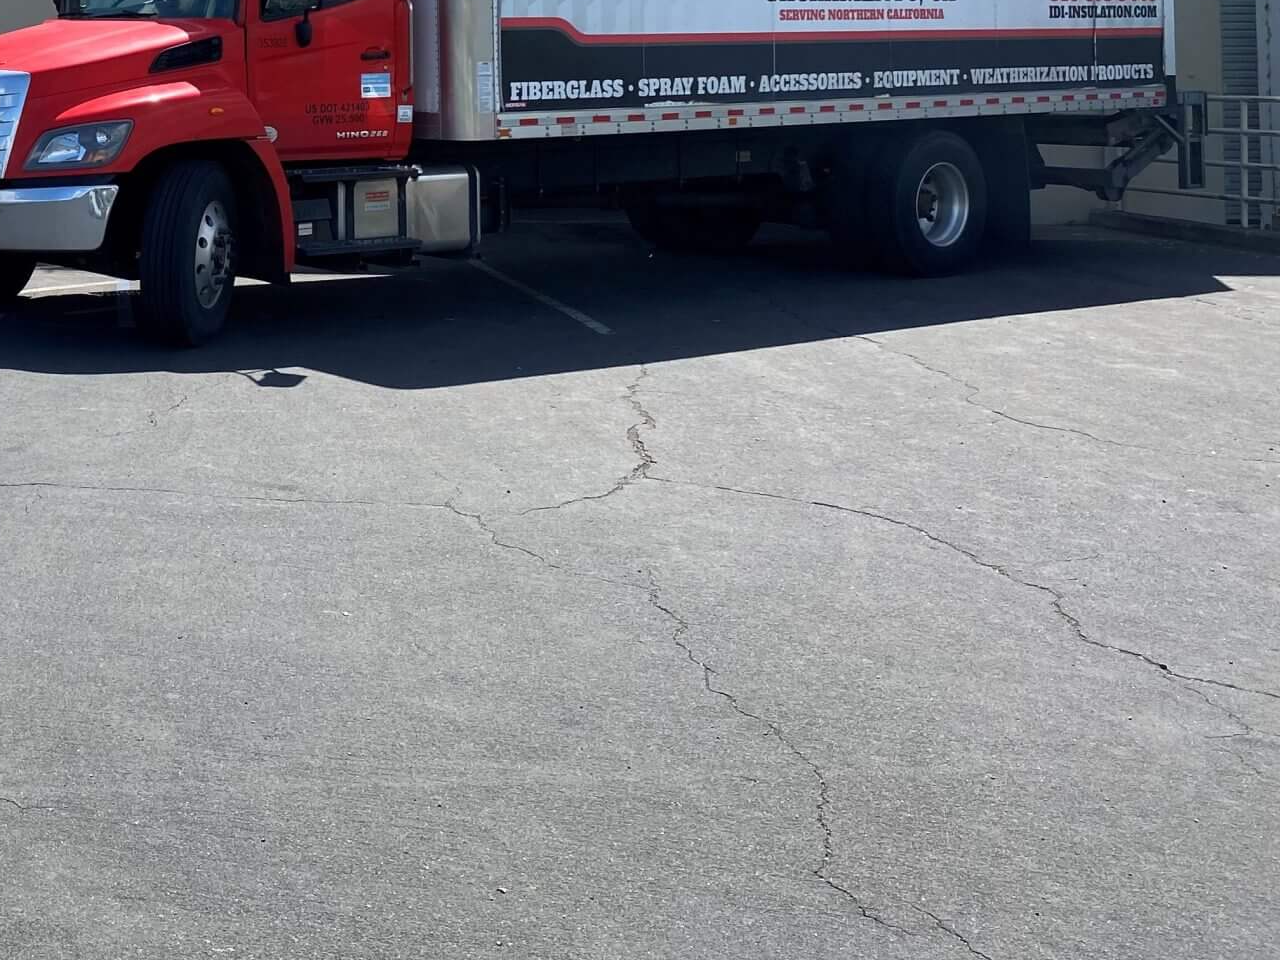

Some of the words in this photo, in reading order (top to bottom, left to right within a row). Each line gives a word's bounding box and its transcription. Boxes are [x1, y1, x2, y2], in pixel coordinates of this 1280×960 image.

[779, 9, 826, 21] SERVING
[828, 9, 885, 21] NORTHERN
[887, 8, 945, 20] CALIFORNIA
[1049, 5, 1157, 18] IDI-INSULATION.COM
[510, 79, 623, 101] FIBERGLASS
[638, 77, 694, 97] SPRAY
[697, 75, 747, 95] FOAM
[758, 71, 862, 93] ACCESSORIES
[873, 69, 960, 88] EQUIPMENT
[970, 65, 1089, 85] WEATHERIZATION
[305, 104, 317, 114] US
[336, 130, 369, 138] HINO
